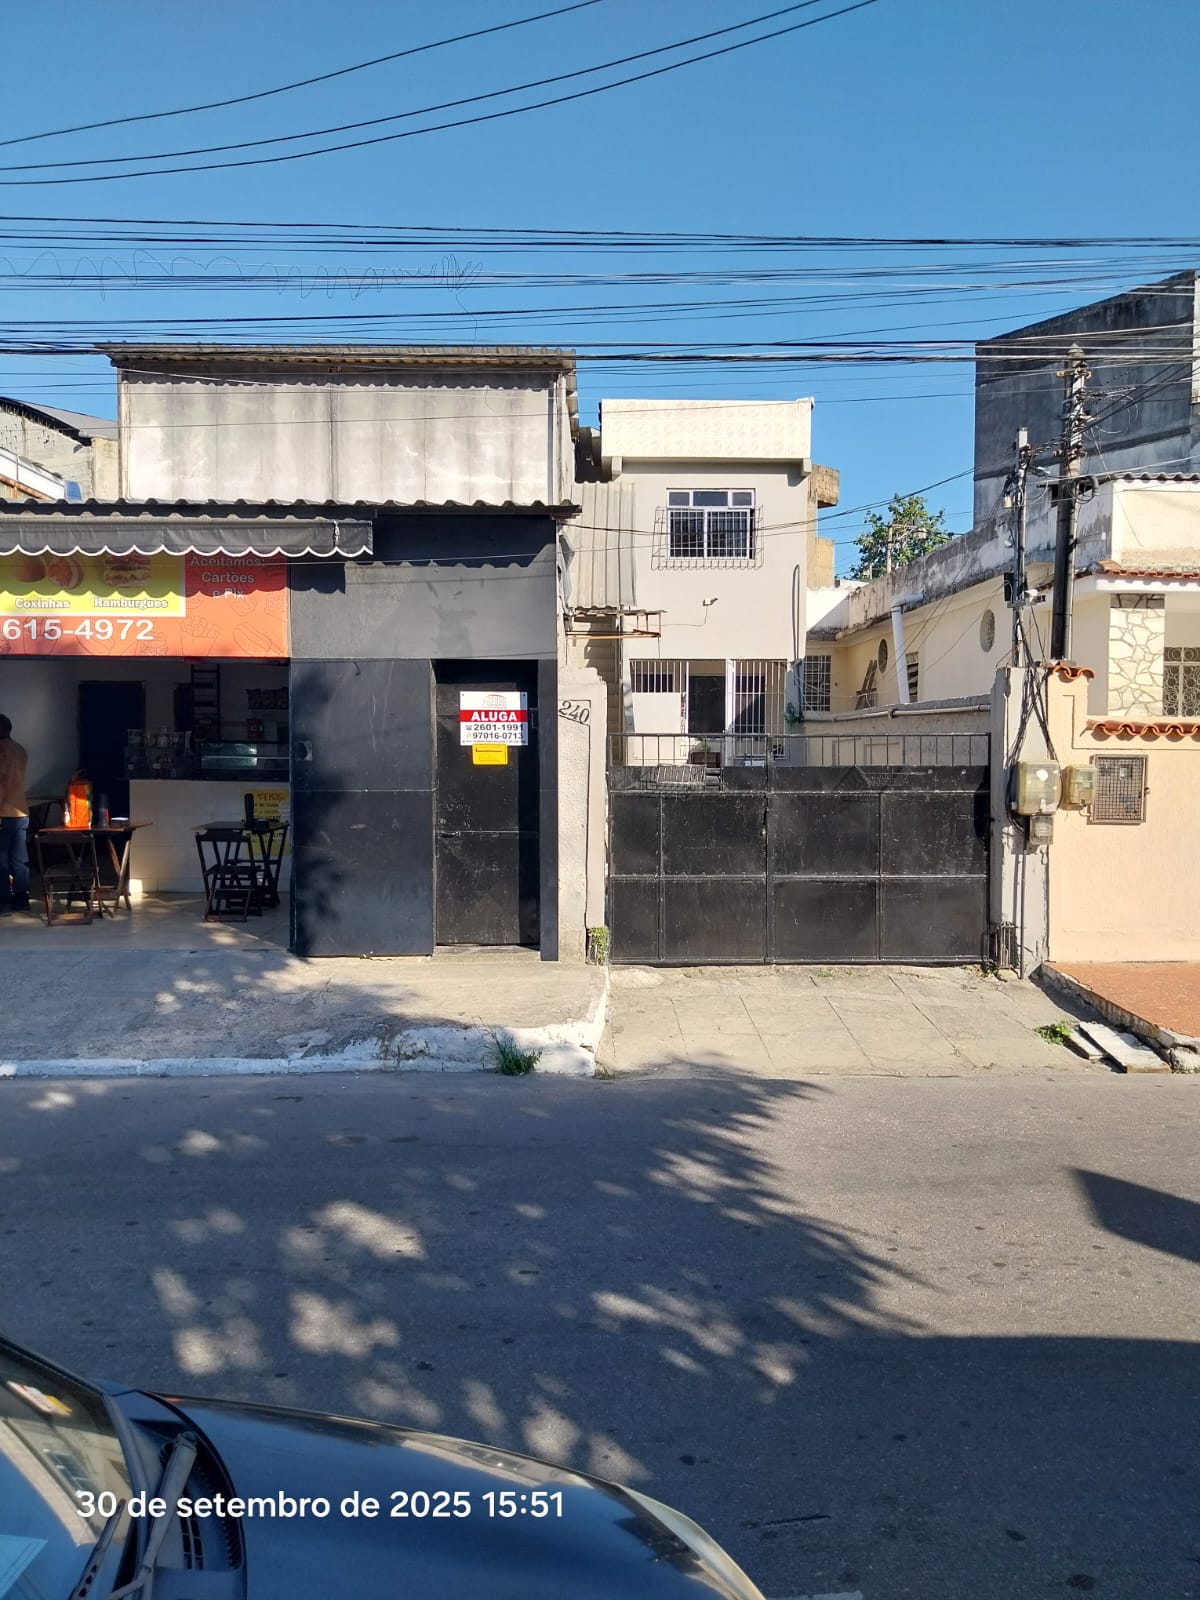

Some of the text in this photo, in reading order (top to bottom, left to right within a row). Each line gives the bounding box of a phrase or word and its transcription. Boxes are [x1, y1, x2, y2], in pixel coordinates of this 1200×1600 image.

[190, 555, 265, 567] Aceitamos:
[201, 572, 255, 583] Cartões
[212, 588, 245, 599] e Pix
[15, 597, 168, 609] Coxinhas Hamburgues
[2, 618, 154, 641] 615-4972
[471, 711, 518, 722] ALUGA
[559, 700, 590, 725] 240
[473, 723, 524, 731] 2601-1991
[472, 732, 524, 740] 97016-0713
